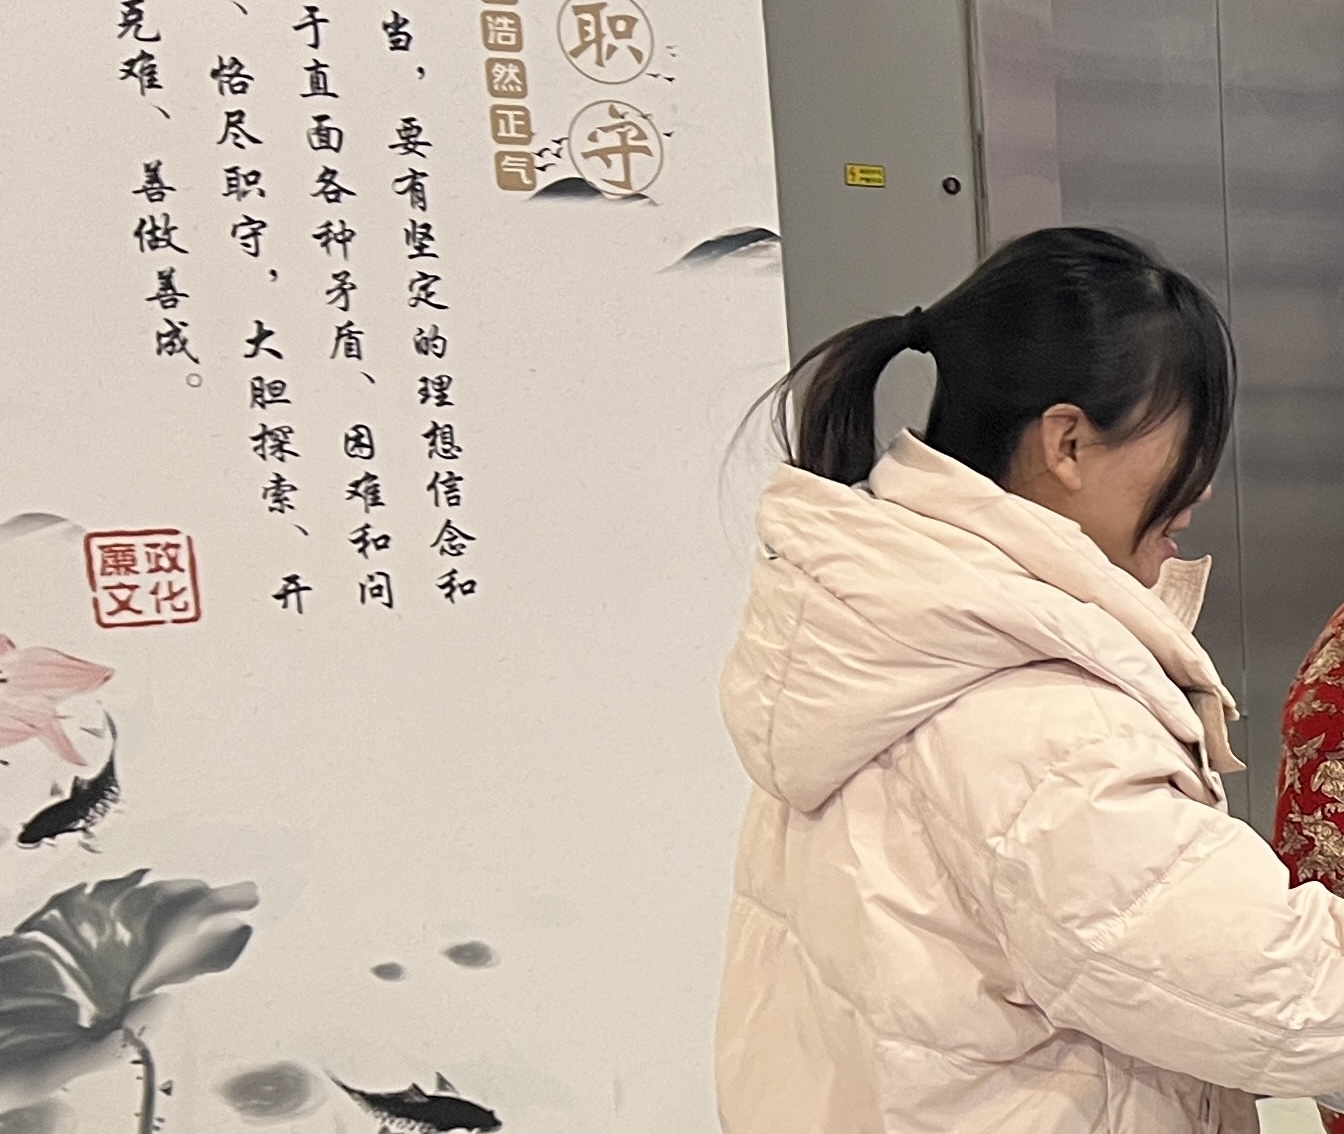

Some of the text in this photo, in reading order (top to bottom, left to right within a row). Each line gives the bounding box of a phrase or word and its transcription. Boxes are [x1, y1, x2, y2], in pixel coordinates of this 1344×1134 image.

[486, 14, 533, 186] 浩然正气
[293, 6, 394, 609] 于直面各种矛盾、困难和问
[102, 581, 189, 616] 文化
